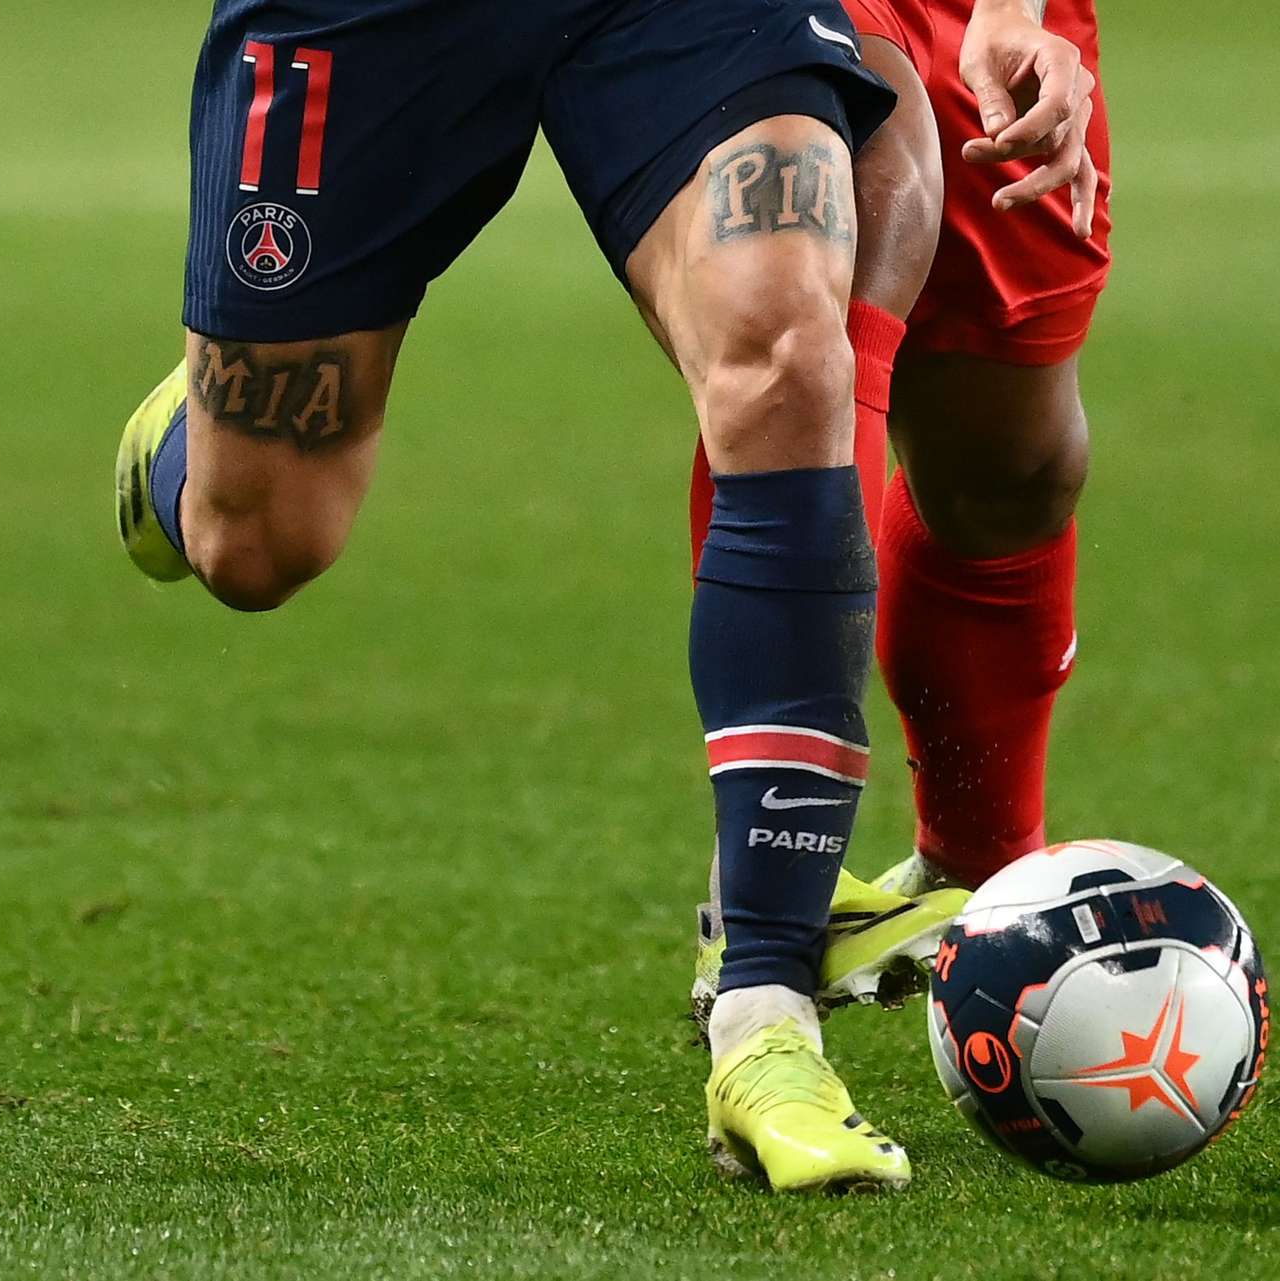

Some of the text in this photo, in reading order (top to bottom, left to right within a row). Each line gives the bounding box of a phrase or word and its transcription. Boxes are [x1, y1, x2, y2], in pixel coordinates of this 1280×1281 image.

[239, 39, 333, 195] 11
[239, 206, 297, 230] PARIS
[199, 341, 344, 439] MIA
[747, 826, 847, 854] PARIS
